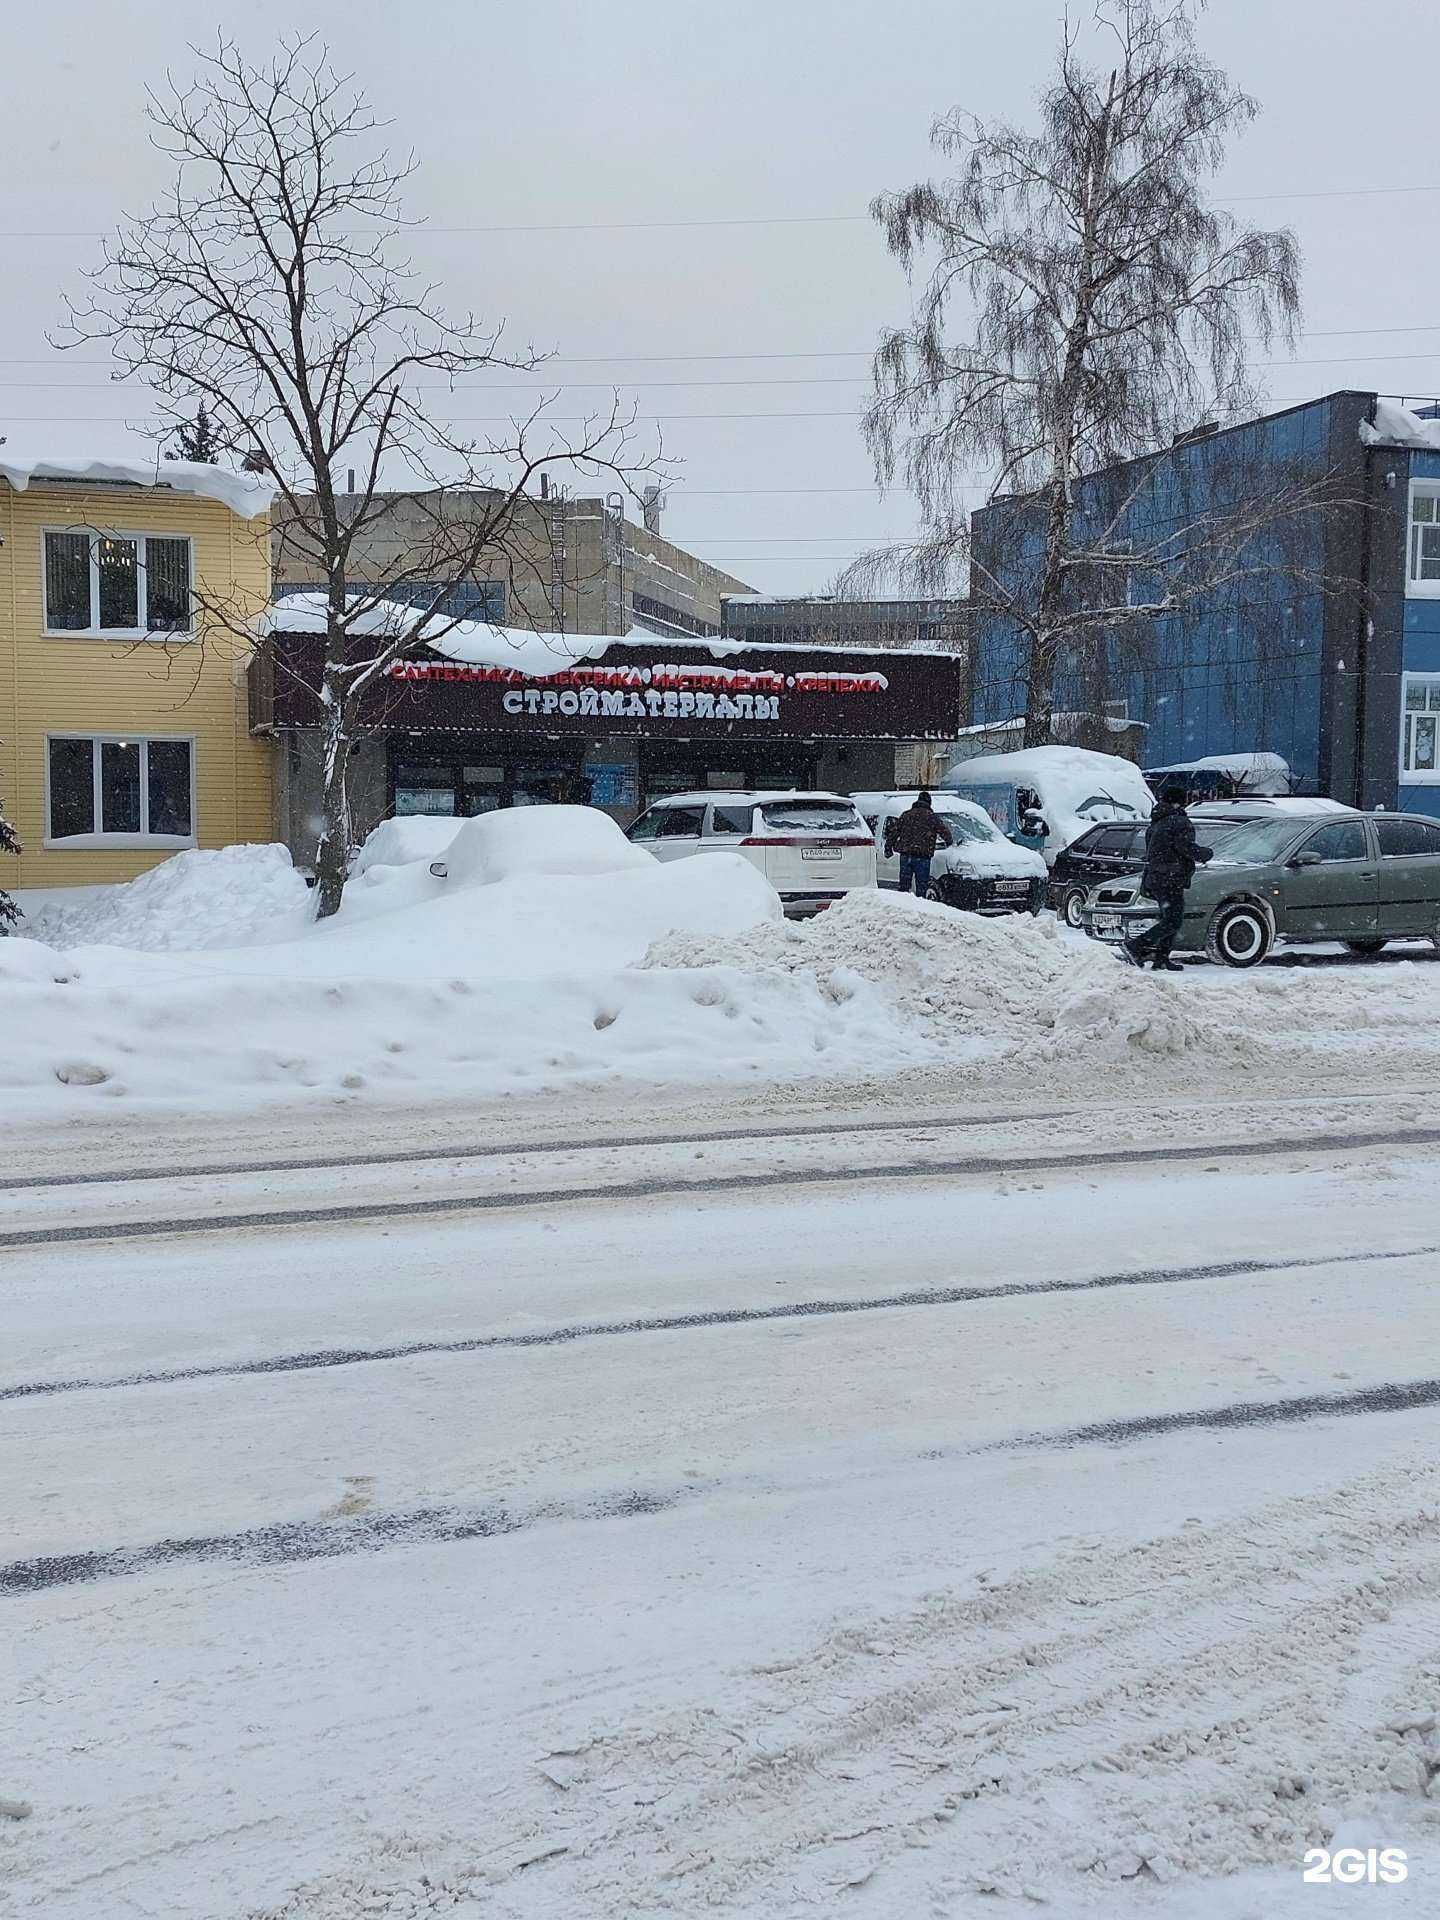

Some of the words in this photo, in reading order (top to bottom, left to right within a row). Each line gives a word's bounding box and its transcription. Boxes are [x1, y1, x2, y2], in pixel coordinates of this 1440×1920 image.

[390, 664, 523, 682] САНТЕХНИКА
[651, 671, 784, 691] ИНСТРУМЕНТЫ
[795, 675, 881, 694] КРЕПЕЖИ
[503, 688, 780, 720] СТРОЙМАТЕРИАЛЫ
